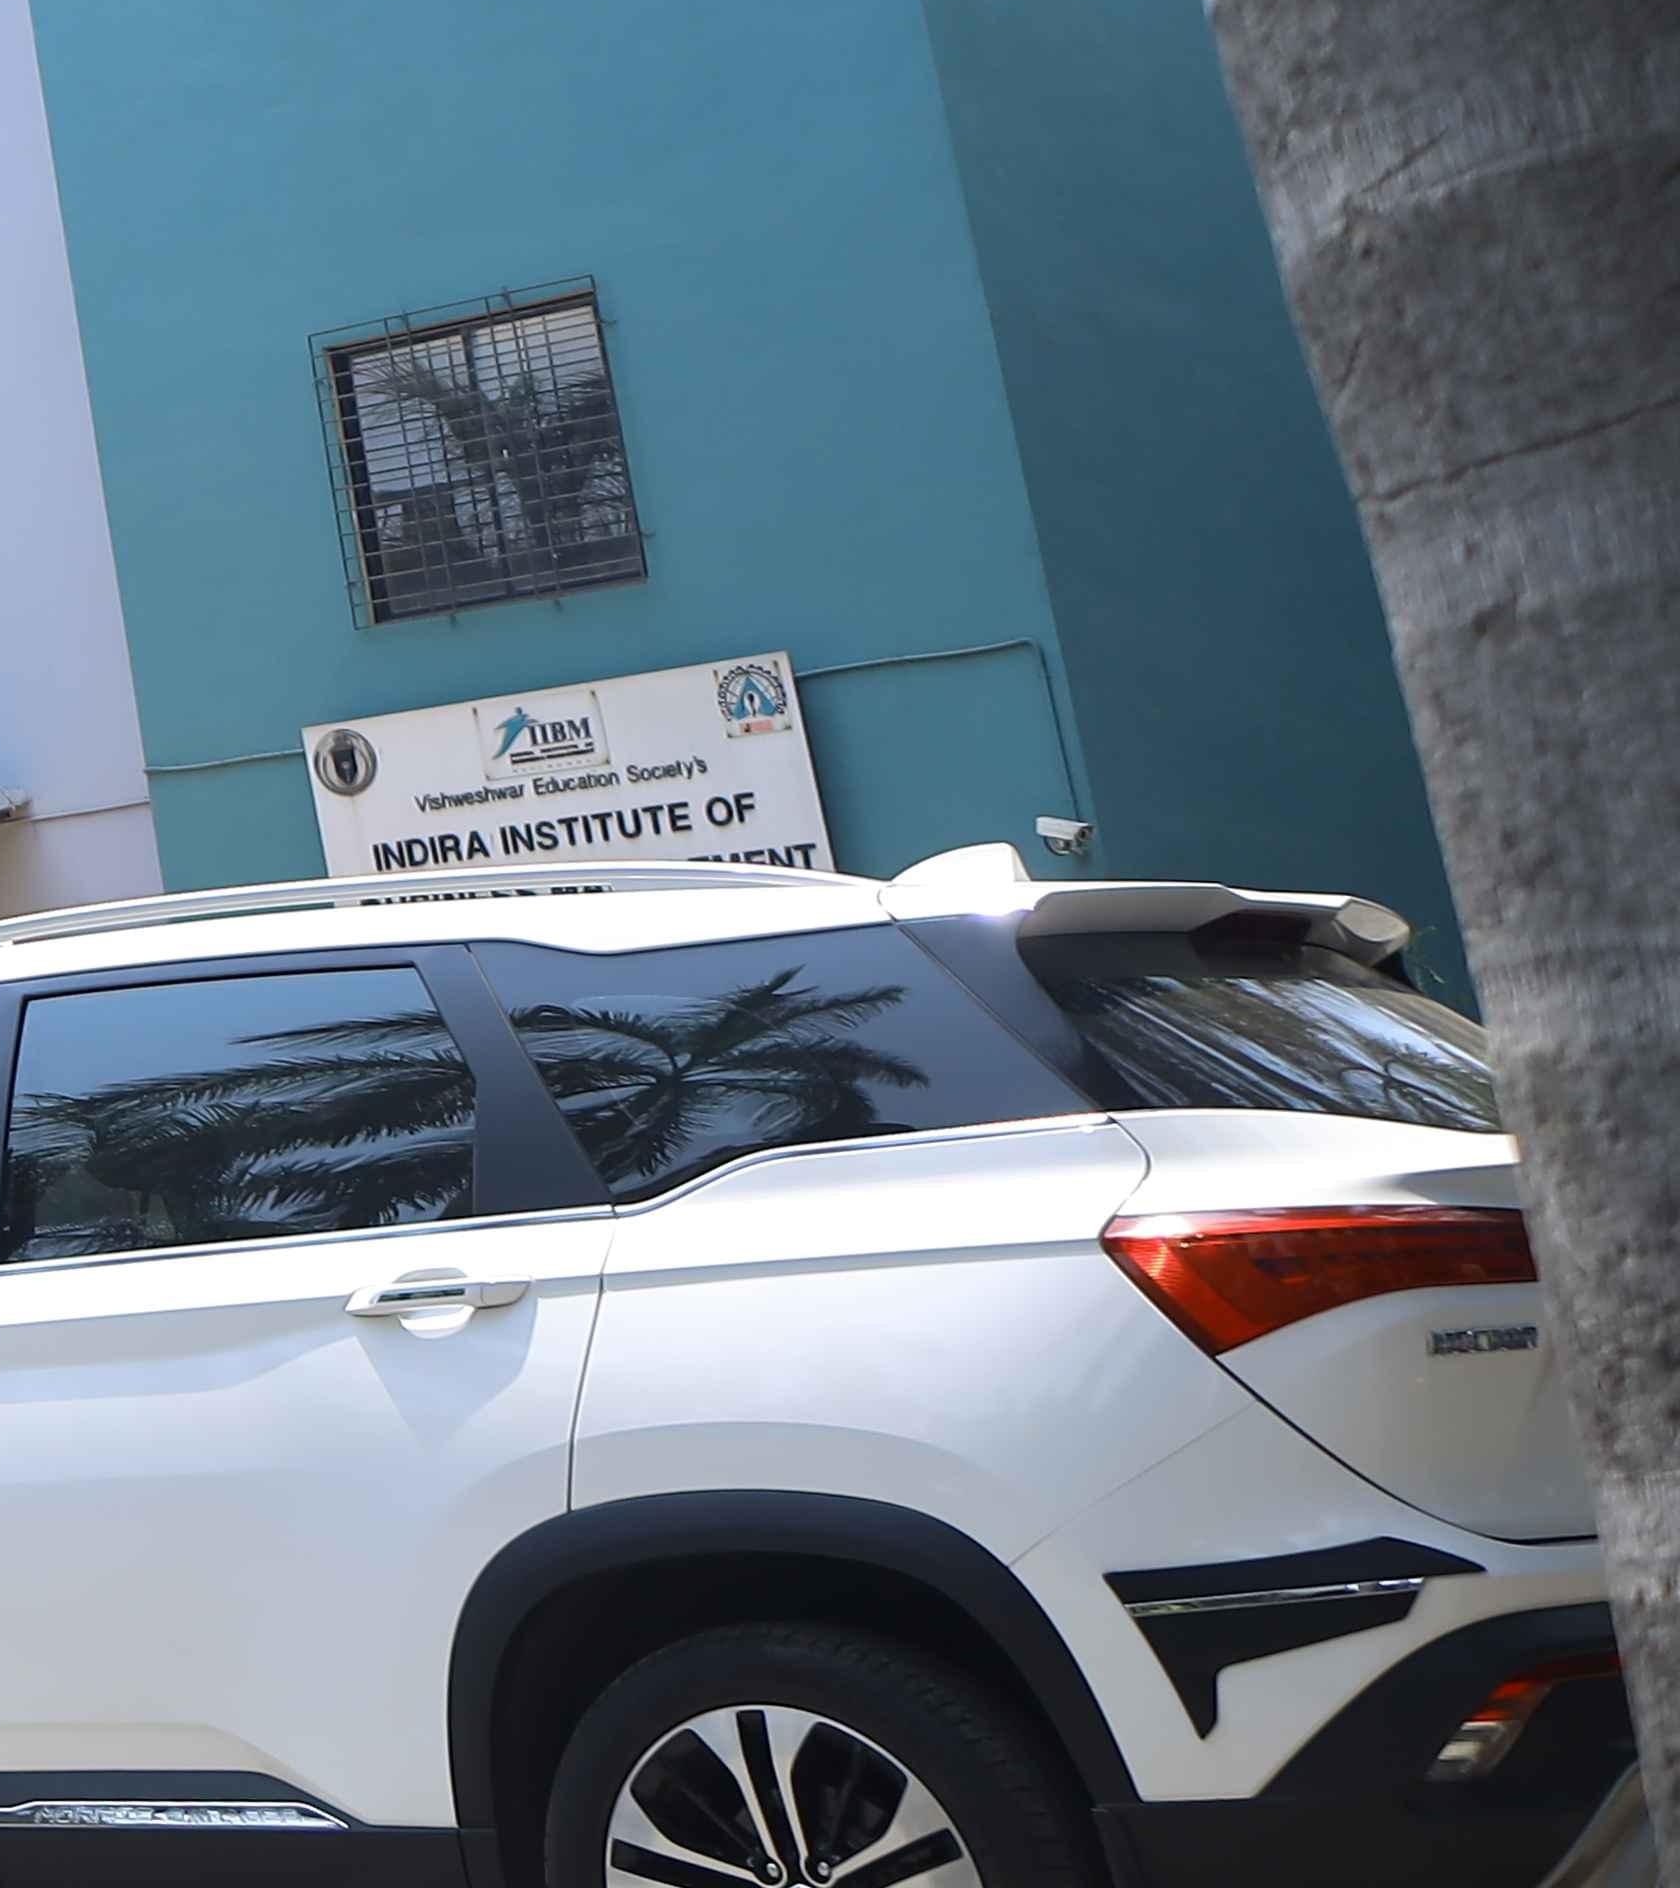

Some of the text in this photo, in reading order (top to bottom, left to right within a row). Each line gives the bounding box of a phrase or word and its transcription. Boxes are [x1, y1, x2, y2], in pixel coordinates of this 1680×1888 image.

[529, 716, 593, 748] IIBM
[415, 755, 708, 813] Vishweshwar Education Society's
[372, 792, 757, 872] INDIRA INSTITUTE OF
